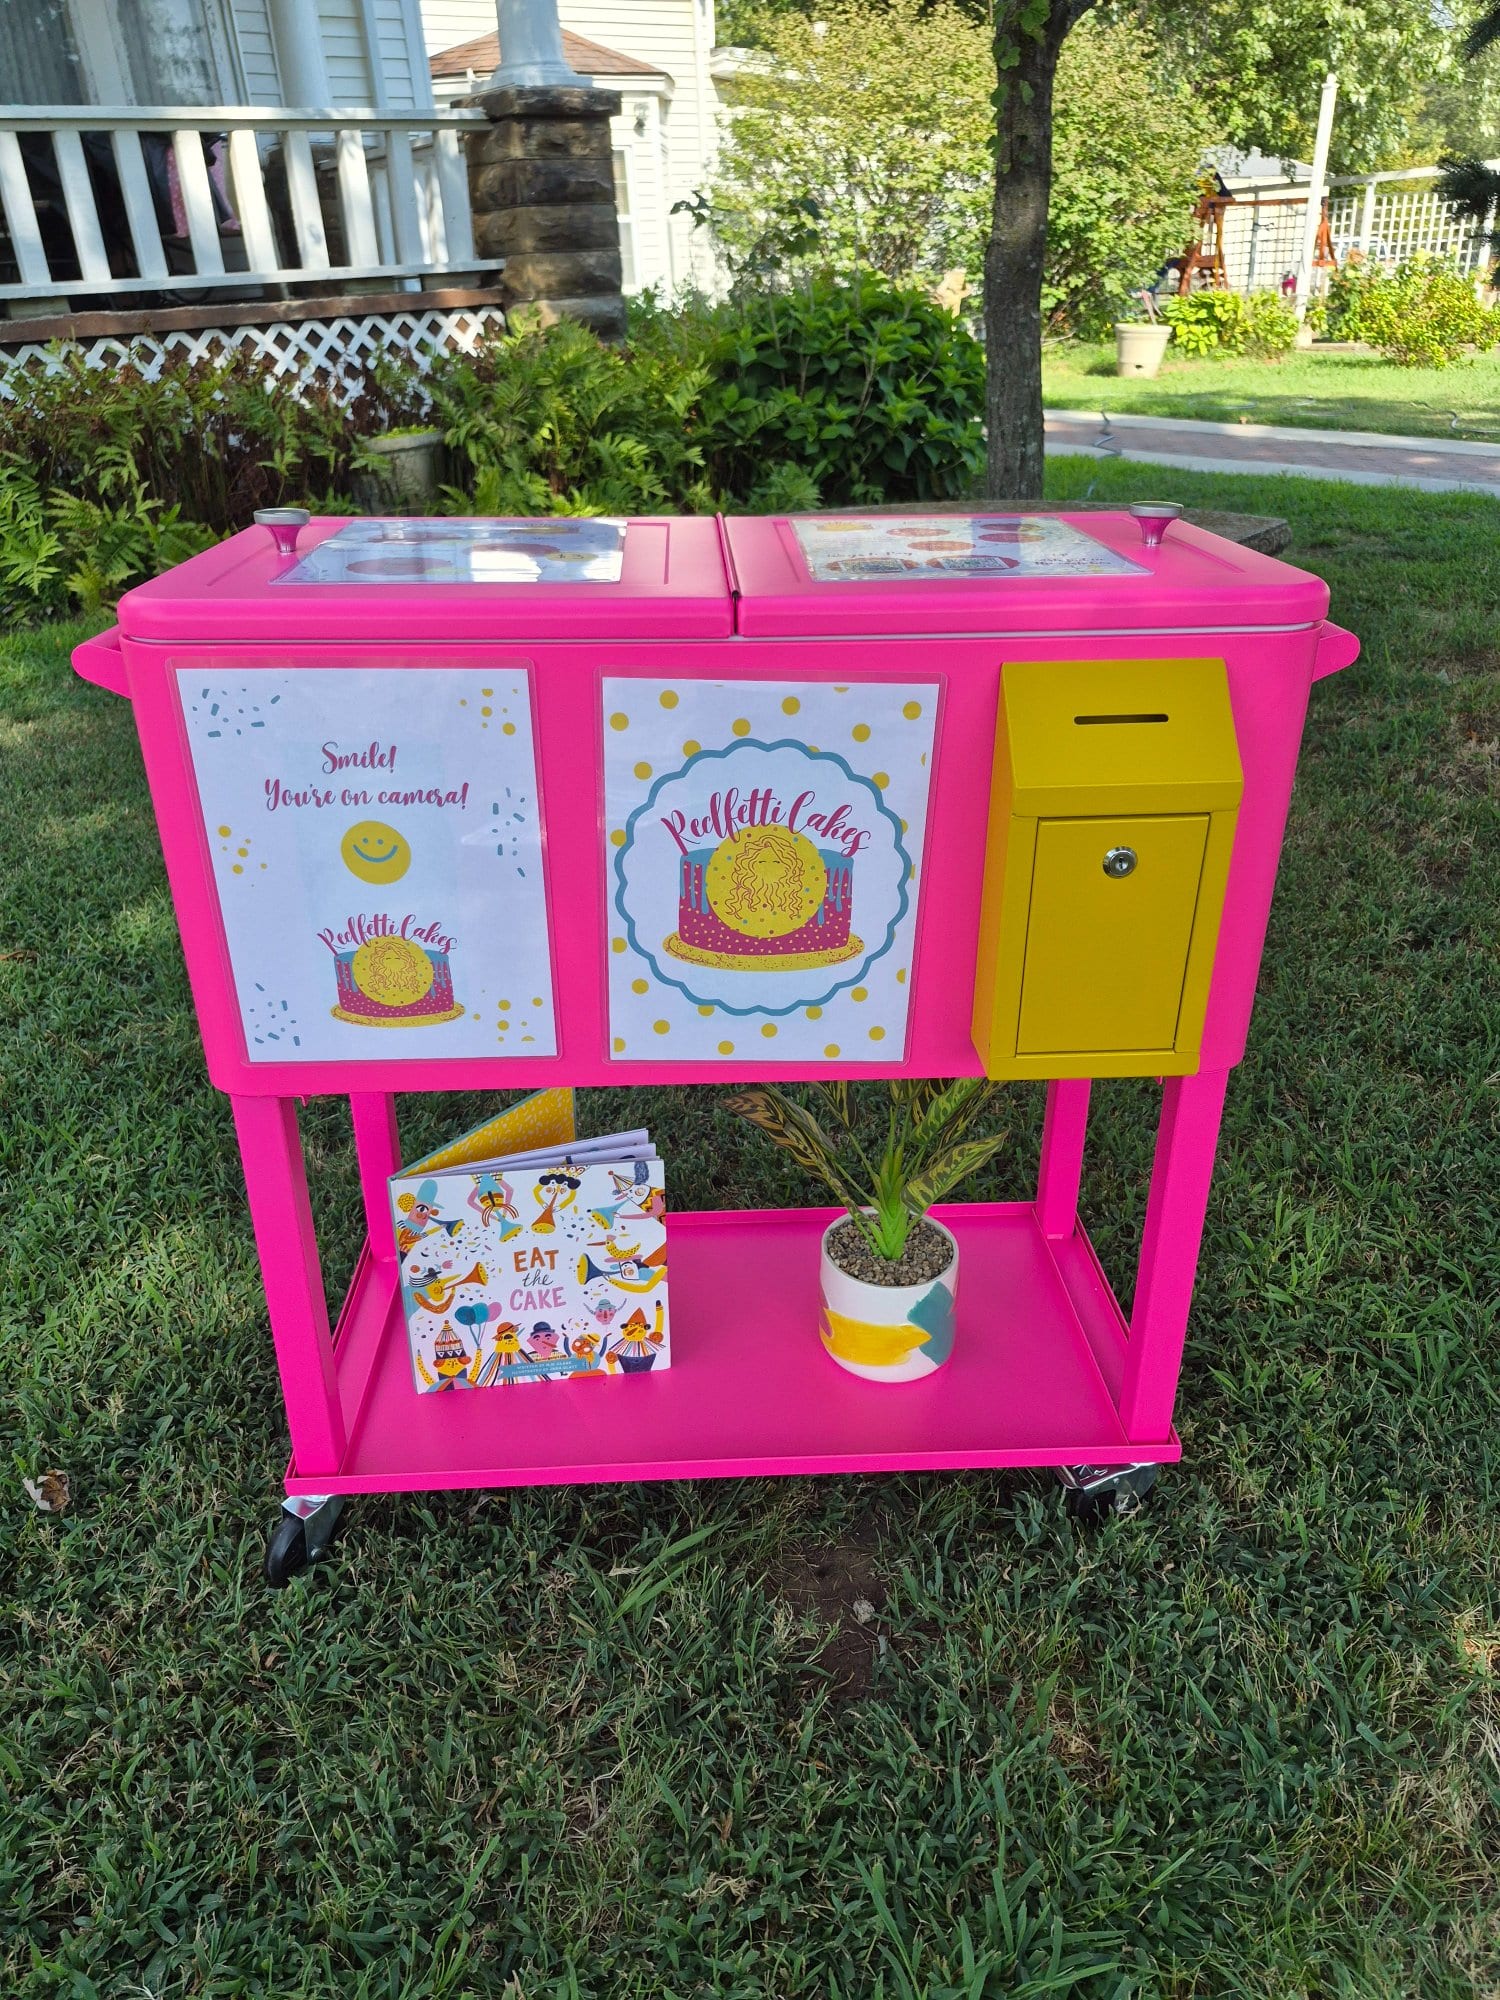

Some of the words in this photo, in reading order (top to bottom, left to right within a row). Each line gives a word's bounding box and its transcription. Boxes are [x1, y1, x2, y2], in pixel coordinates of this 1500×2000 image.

[322, 741, 397, 774] Smile!
[264, 778, 336, 812] You're
[341, 788, 373, 806] on
[378, 781, 470, 811] camera!
[788, 790, 872, 859] Cakes
[400, 914, 458, 956] Cakes
[513, 1246, 560, 1273] EAT
[522, 1268, 554, 1287] the
[509, 1286, 567, 1311] CAKE
